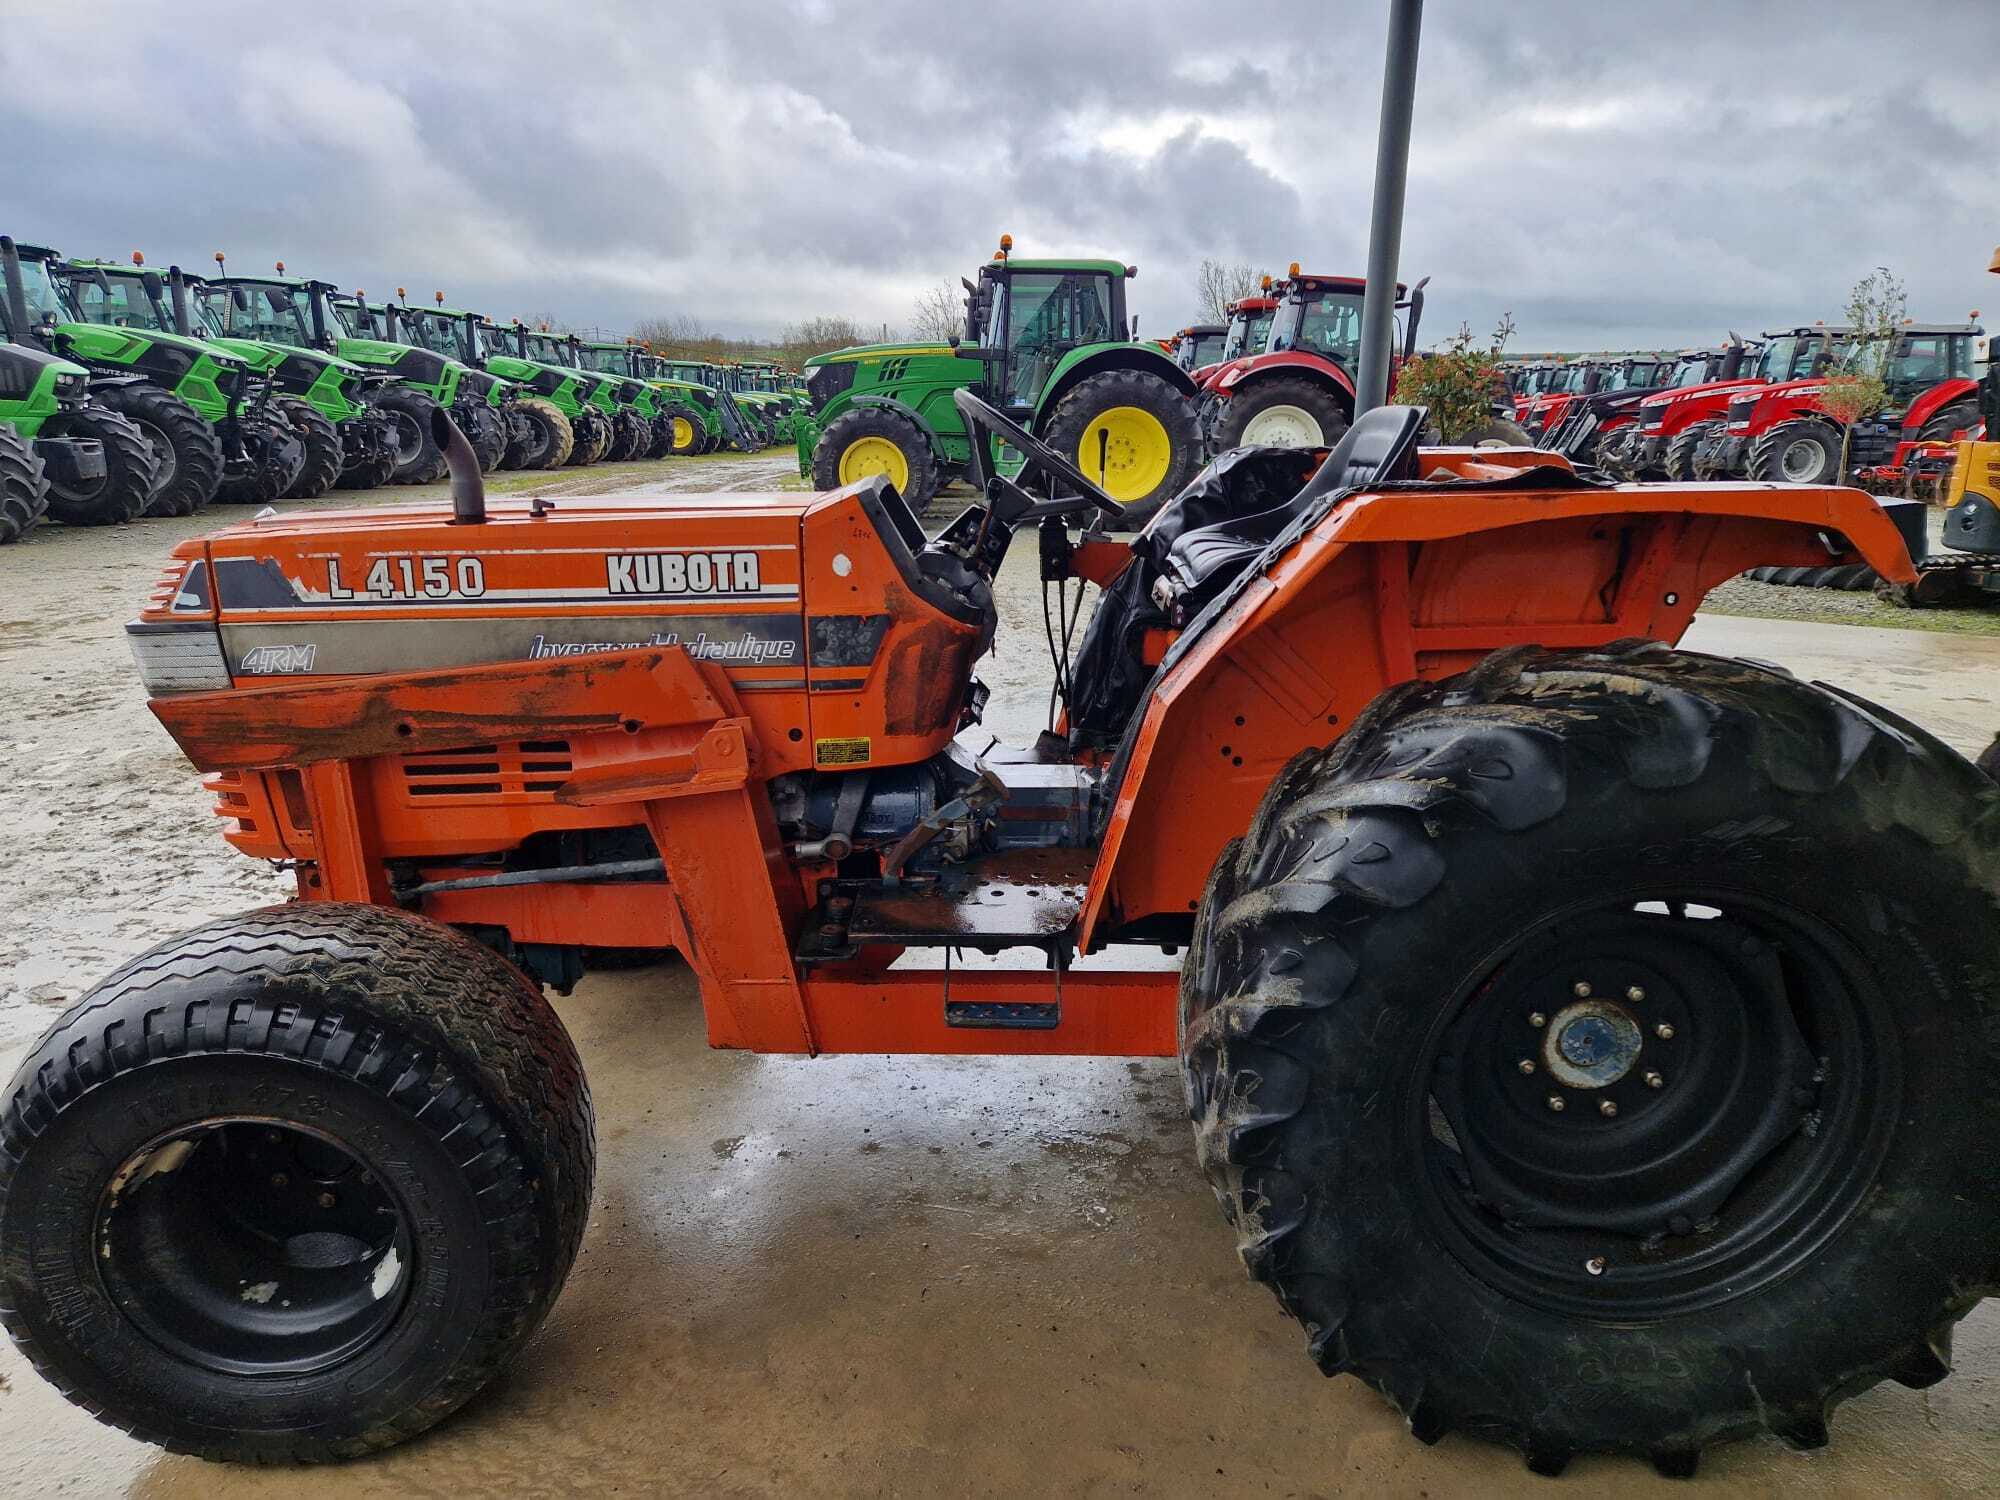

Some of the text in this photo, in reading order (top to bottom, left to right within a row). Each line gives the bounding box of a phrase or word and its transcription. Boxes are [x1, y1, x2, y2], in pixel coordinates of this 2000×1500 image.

[327, 556, 486, 599] L 4150
[606, 551, 761, 594] KUBOTA
